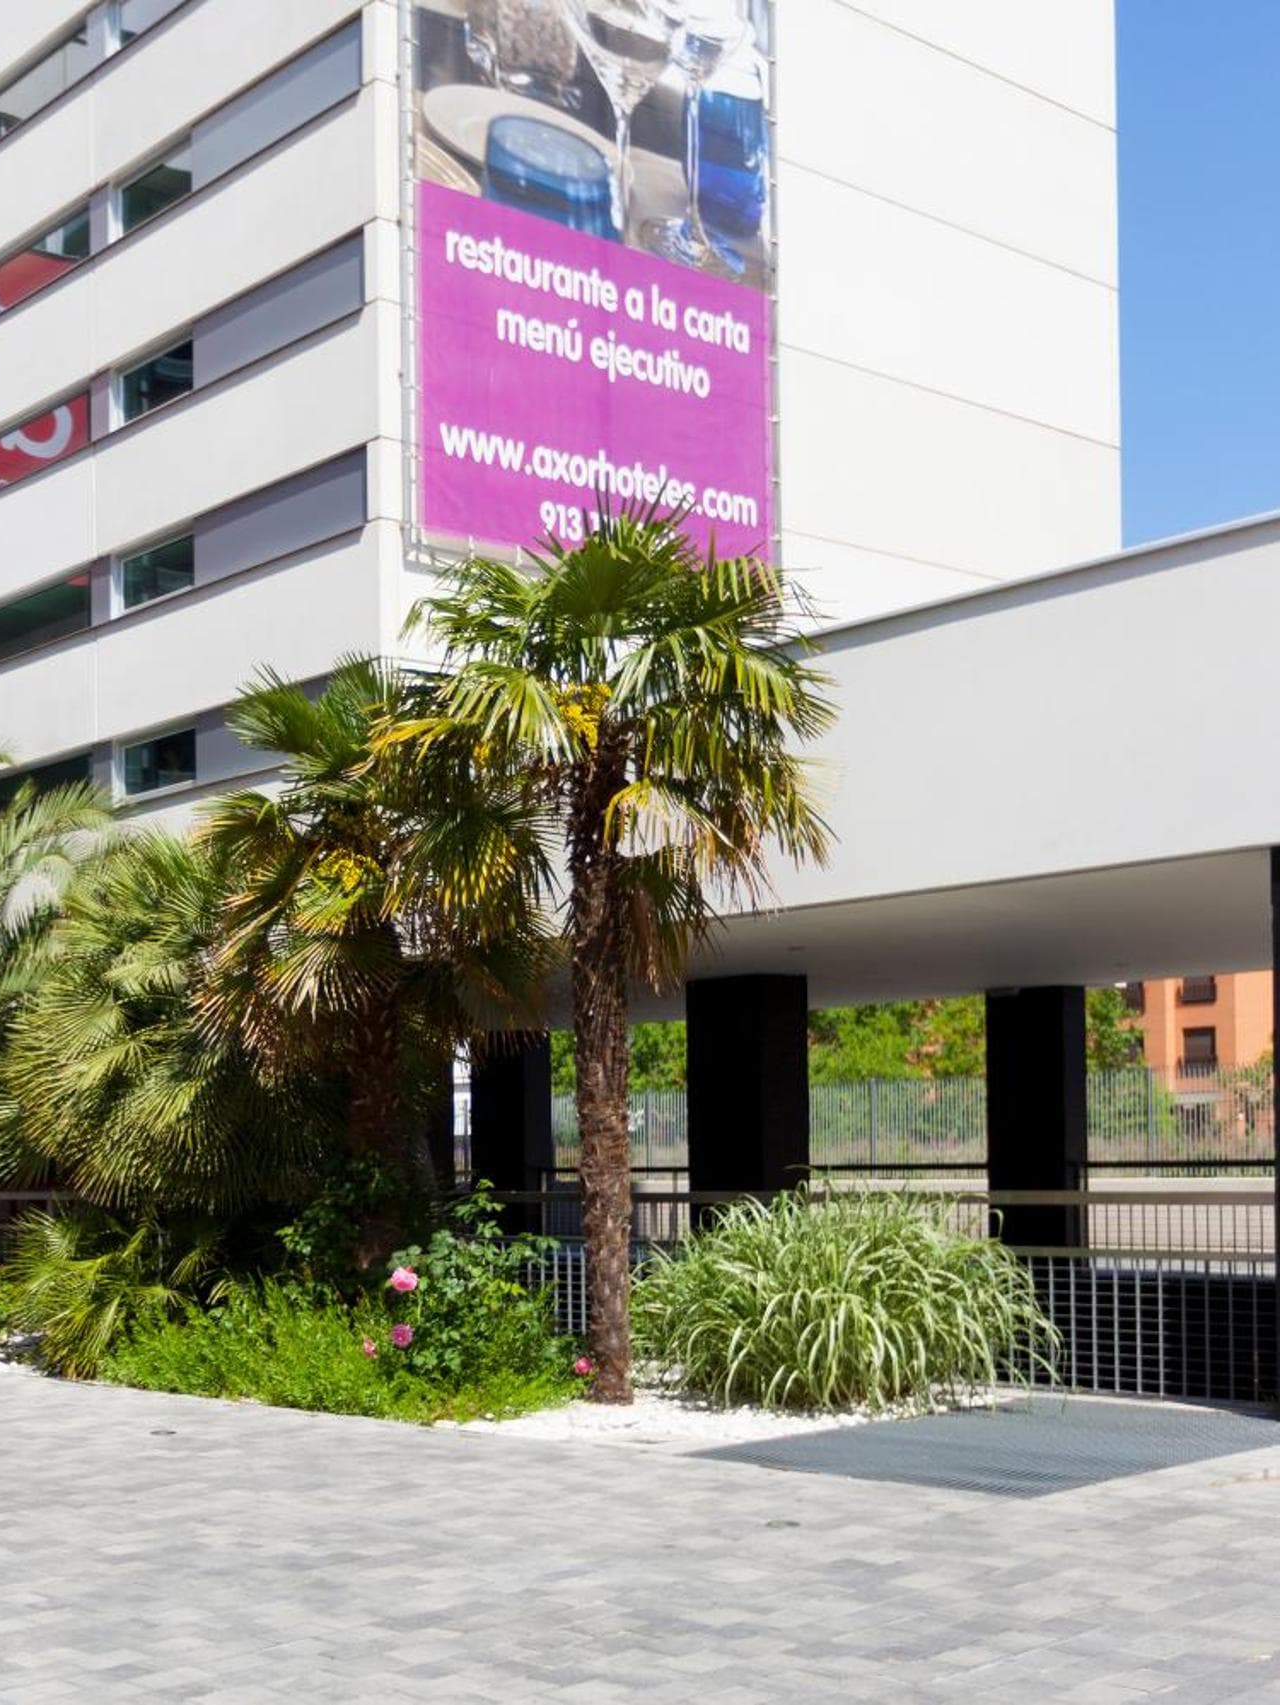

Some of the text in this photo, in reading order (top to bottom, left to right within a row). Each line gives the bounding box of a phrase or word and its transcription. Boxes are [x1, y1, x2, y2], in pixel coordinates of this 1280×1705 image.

[445, 230, 751, 354] restaurante a la carta
[496, 307, 711, 398] menú ejecutivo
[440, 422, 758, 527] www.axorhoteles.com
[540, 501, 583, 542] 913
